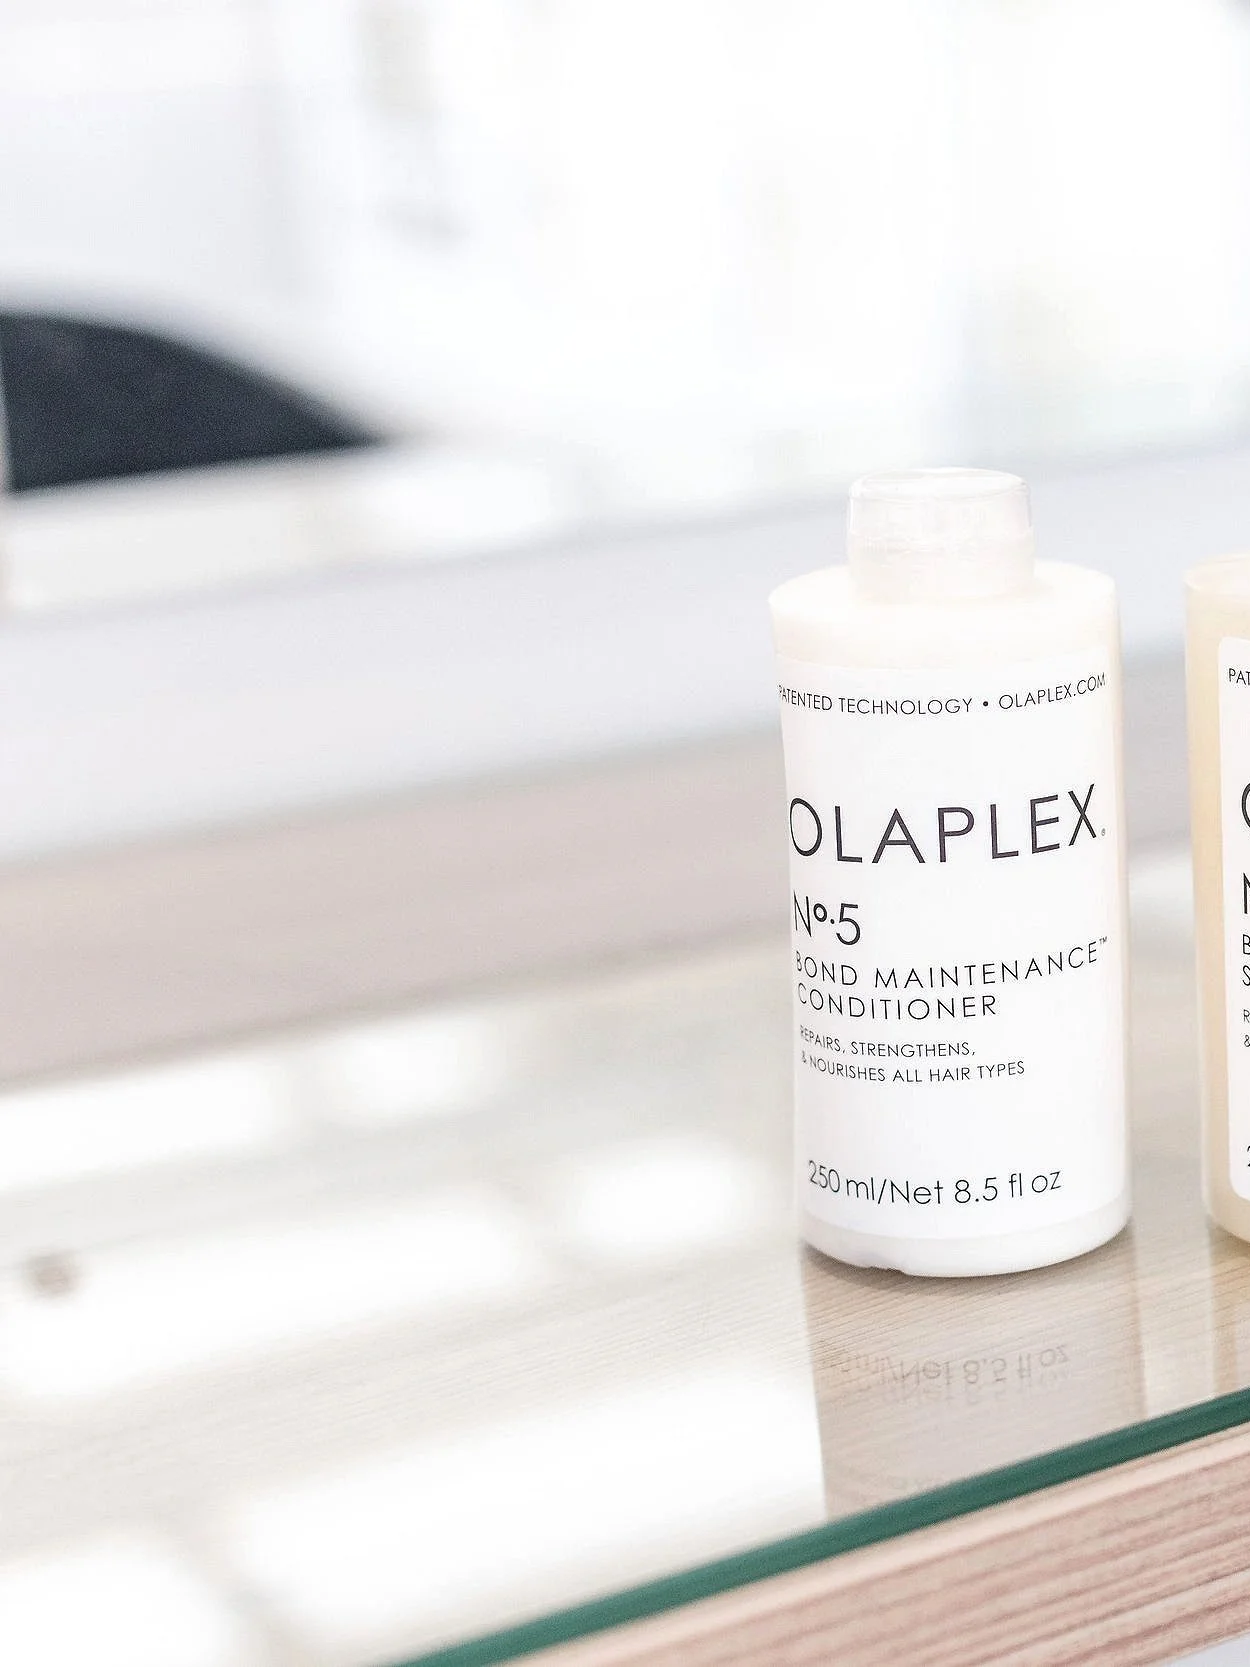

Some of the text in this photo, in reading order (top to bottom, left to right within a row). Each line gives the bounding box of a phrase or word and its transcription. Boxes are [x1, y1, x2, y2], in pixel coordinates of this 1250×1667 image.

[838, 696, 973, 715] TECHNOLOGY
[998, 671, 1107, 711] OLAPLEX.COM
[796, 949, 858, 986] BOND
[797, 981, 997, 1021] CONDITIONER
[850, 1041, 976, 1058] STRENGTHENS,
[810, 1055, 886, 1082] NOURISHES
[892, 1068, 923, 1083] ALL
[929, 1066, 971, 1082] HAIR
[976, 1060, 1026, 1079] TYPES
[808, 1159, 1062, 1205] 250 ml/Net 8.5 fl oz
